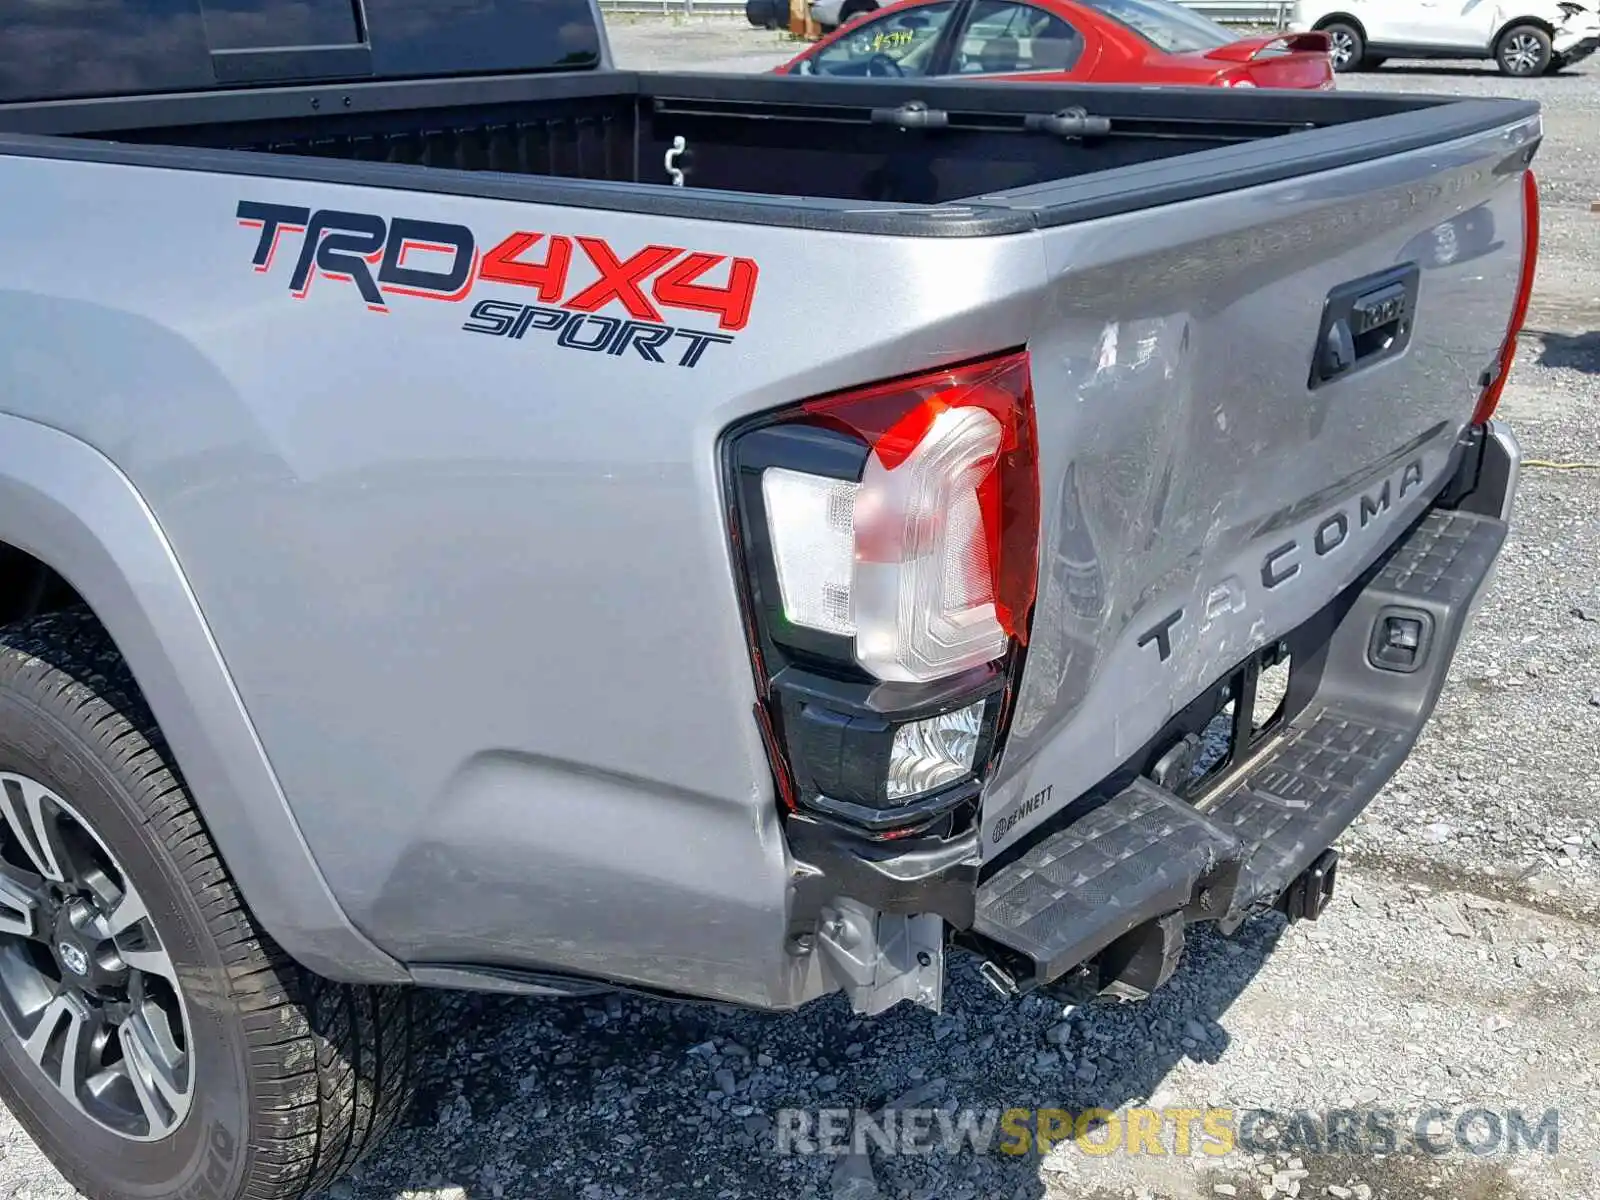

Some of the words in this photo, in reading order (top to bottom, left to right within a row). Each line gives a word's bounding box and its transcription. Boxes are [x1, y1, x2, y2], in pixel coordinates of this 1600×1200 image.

[462, 300, 734, 369] SPORT
[1137, 459, 1424, 662] TACOMA
[1007, 784, 1053, 831] BENNETT
